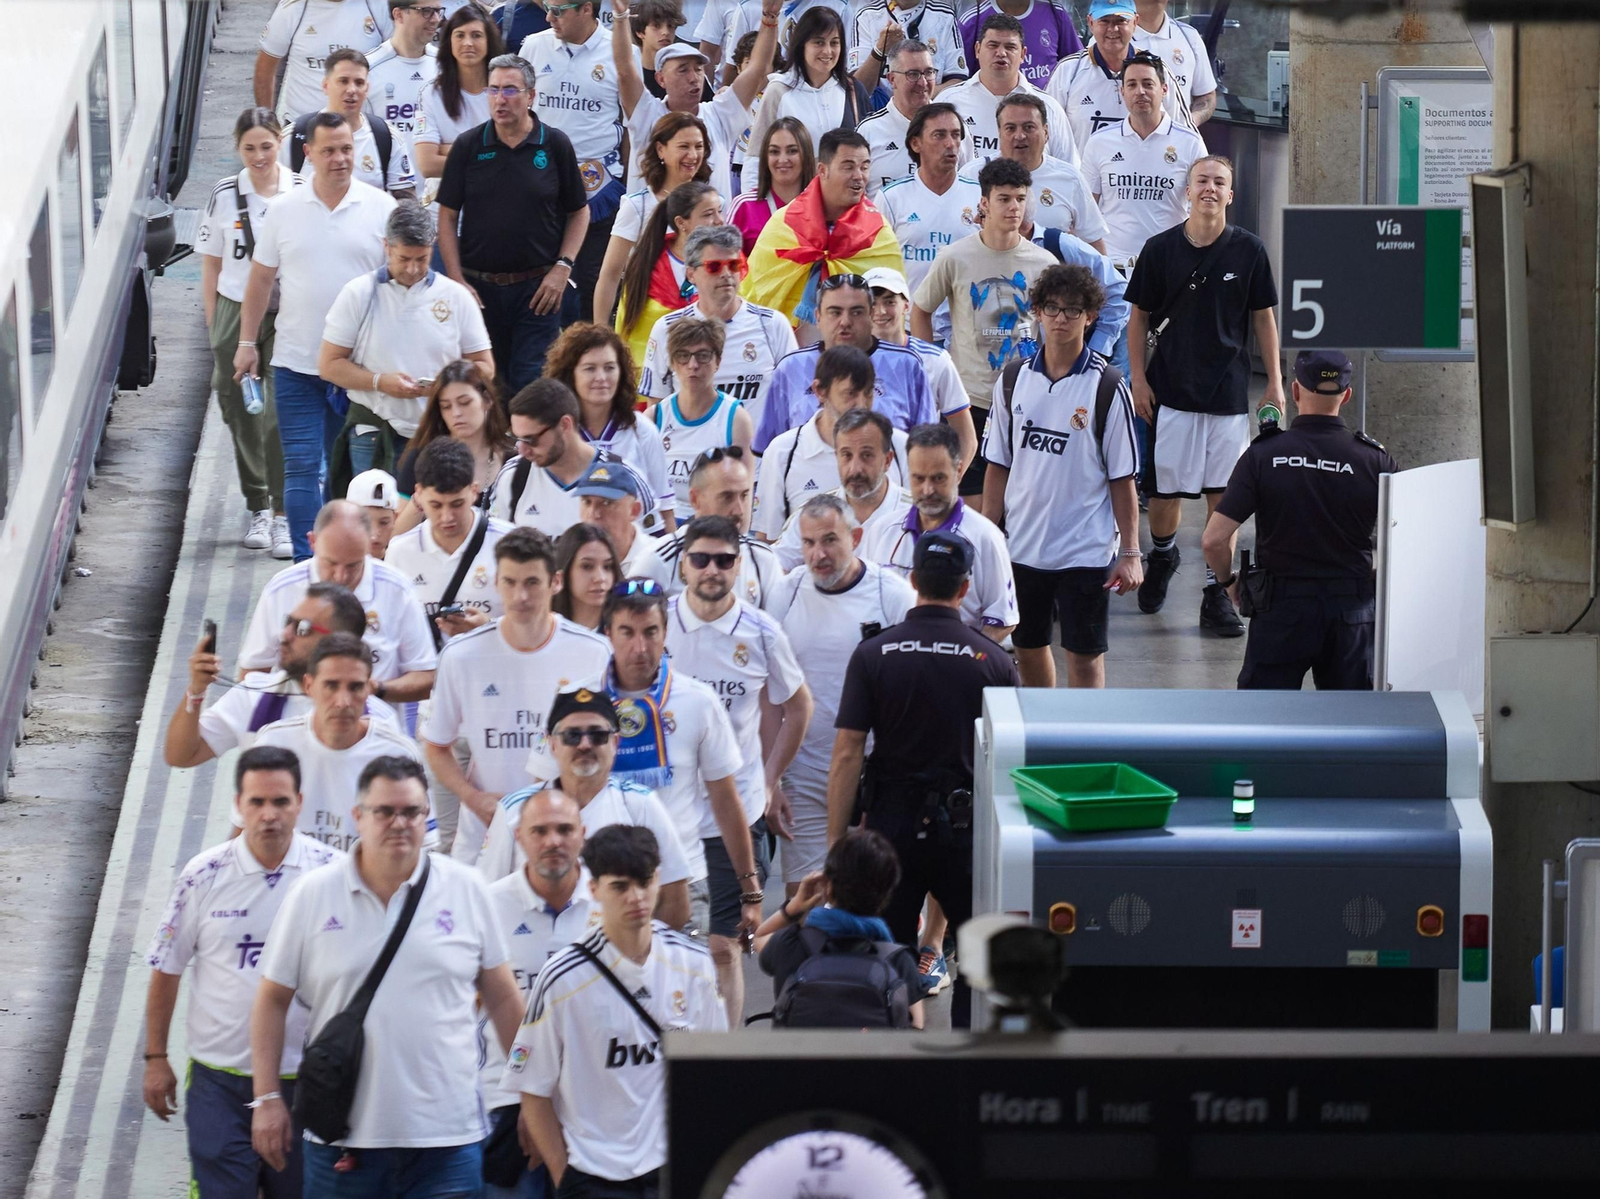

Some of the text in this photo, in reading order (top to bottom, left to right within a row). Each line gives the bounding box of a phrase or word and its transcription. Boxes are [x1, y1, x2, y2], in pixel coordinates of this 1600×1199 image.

[1020, 64, 1050, 79] rates
[560, 81, 580, 95] Fly
[538, 94, 602, 112] Emirates
[1425, 108, 1486, 118] Documentos
[1108, 172, 1175, 190] Emirates
[1118, 189, 1165, 201] FLY BETTER
[1376, 219, 1401, 236] Vía
[930, 231, 952, 245] Fly
[1376, 241, 1415, 251] PLATFORM
[1291, 280, 1325, 340] 5
[1320, 370, 1339, 378] CNP
[716, 376, 760, 401] win
[1272, 456, 1354, 475] POLICIA
[881, 640, 975, 658] POLICIA
[516, 710, 542, 728] Fly
[484, 728, 538, 749] Emir
[315, 810, 342, 830] Fly
[605, 1037, 660, 1070] bw
[979, 1091, 1061, 1124] Hora
[1101, 1103, 1152, 1123] TIME
[1190, 1090, 1268, 1124] Tren
[807, 1145, 845, 1170] 12
